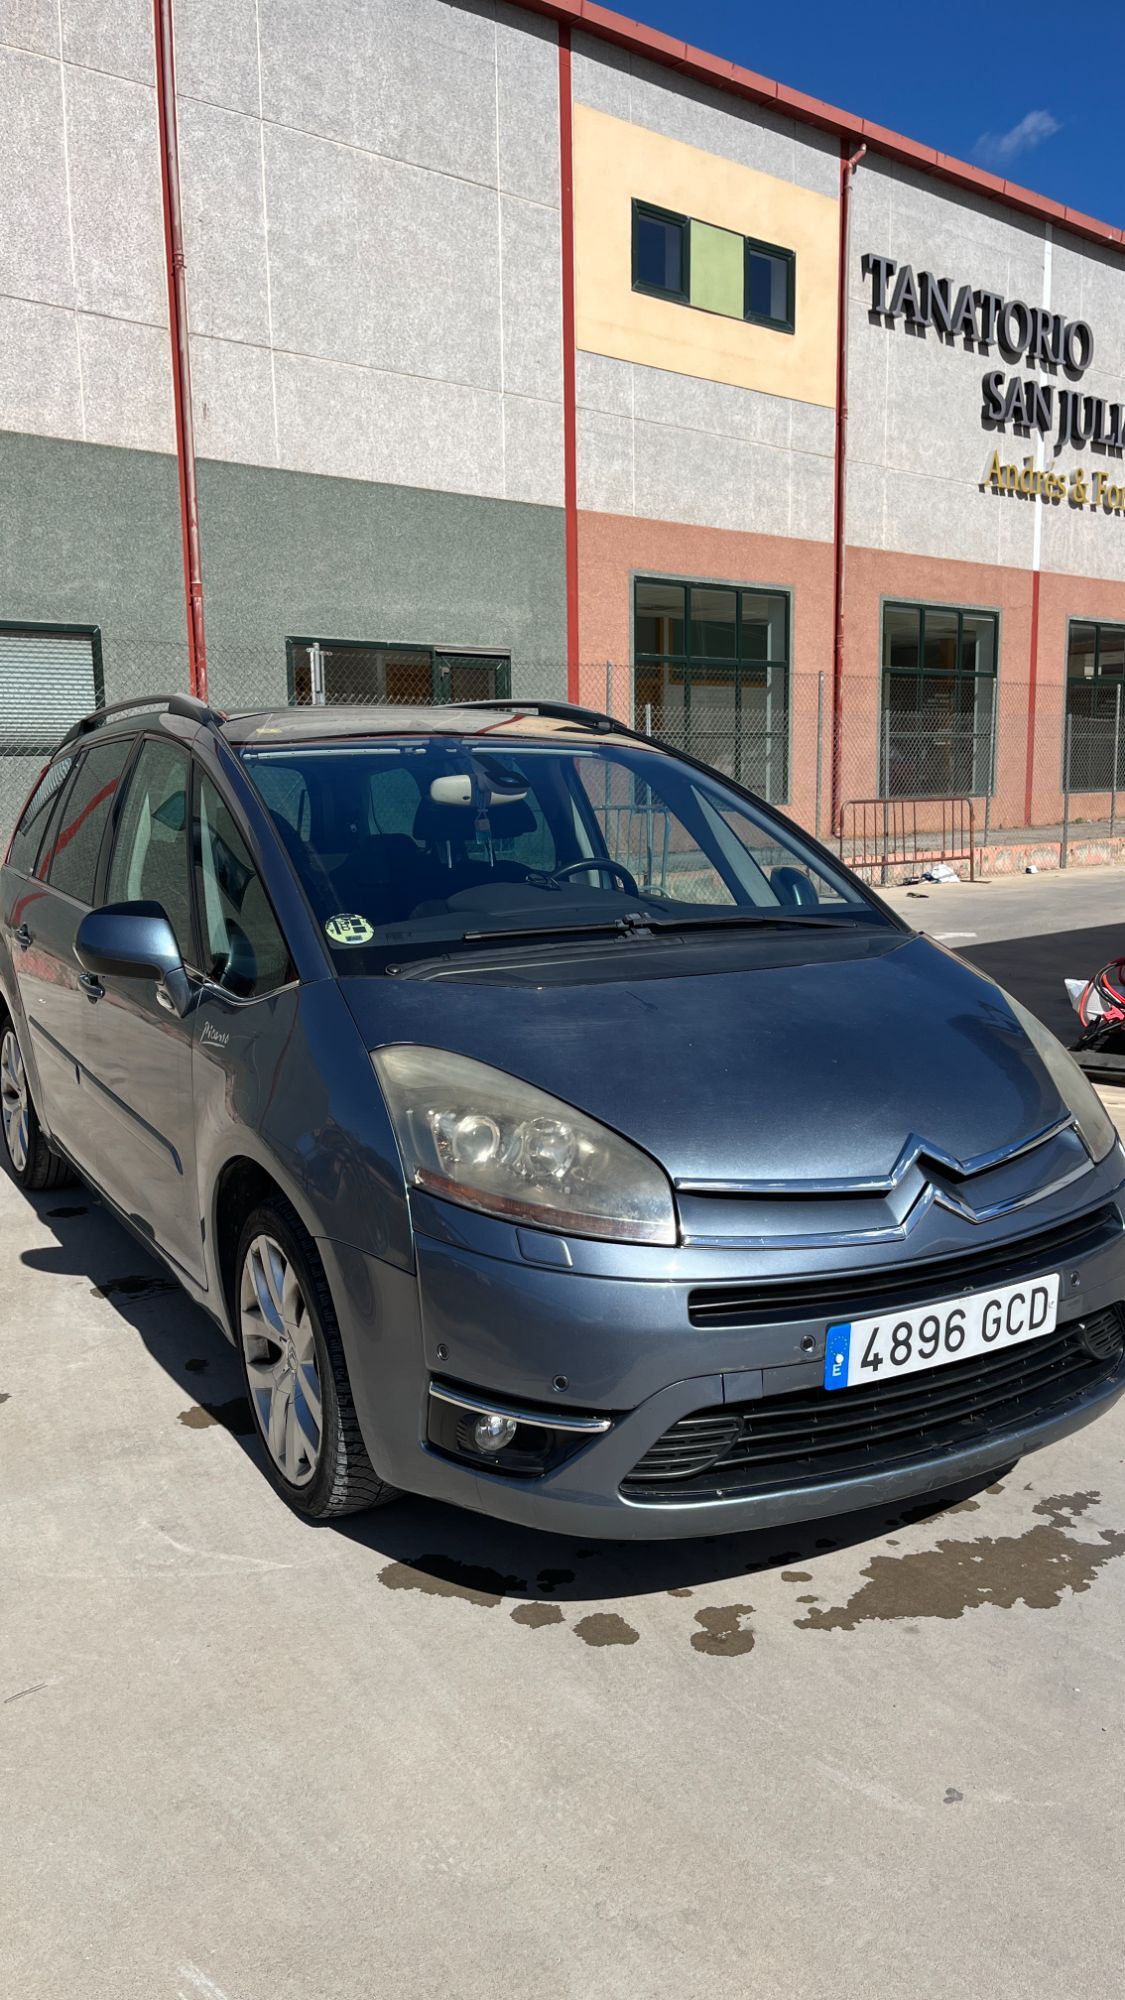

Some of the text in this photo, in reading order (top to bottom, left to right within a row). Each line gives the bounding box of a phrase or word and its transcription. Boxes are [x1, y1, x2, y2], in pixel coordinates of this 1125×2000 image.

[861, 253, 1094, 371] TANATORIO
[982, 370, 1125, 449] SAN JULI
[983, 448, 1067, 498] Andrés
[1070, 467, 1088, 503] &
[860, 1286, 1049, 1372] 4896 GCD
